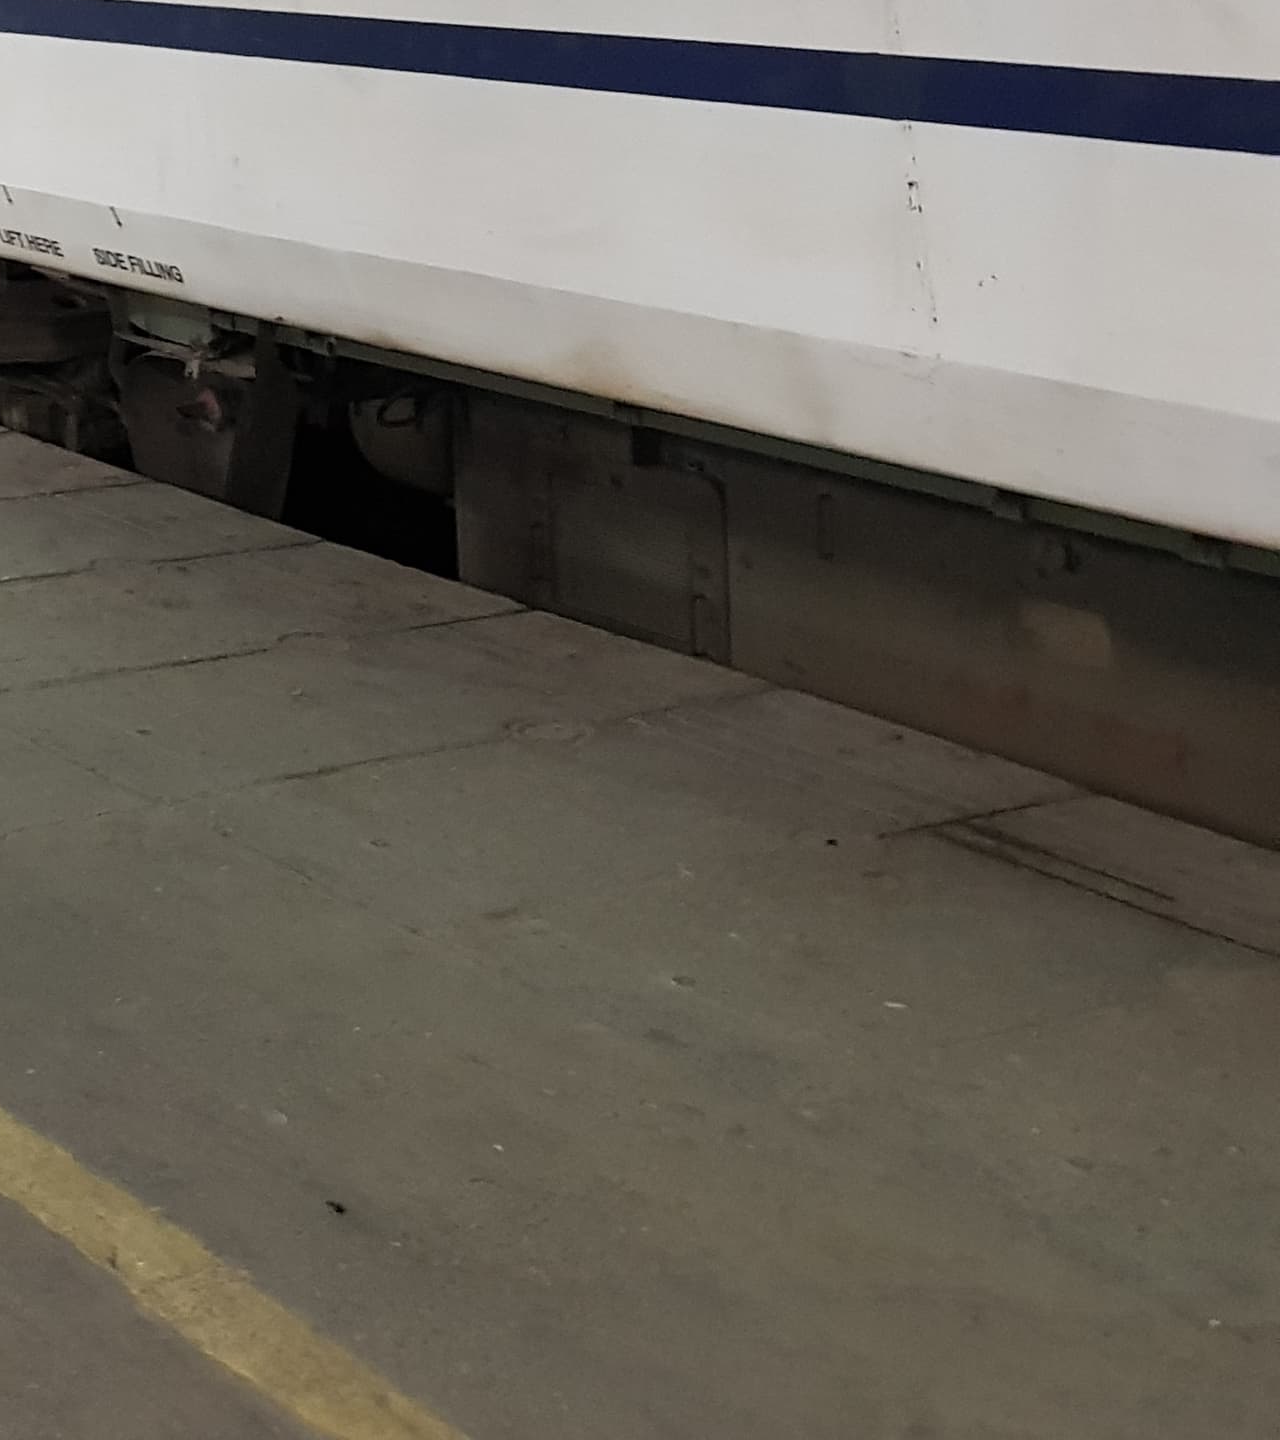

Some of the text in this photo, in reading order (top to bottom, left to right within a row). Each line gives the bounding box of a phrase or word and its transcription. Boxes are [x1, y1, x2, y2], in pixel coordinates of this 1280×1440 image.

[25, 234, 64, 257] HERE
[92, 247, 184, 284] SIDE FILLING
